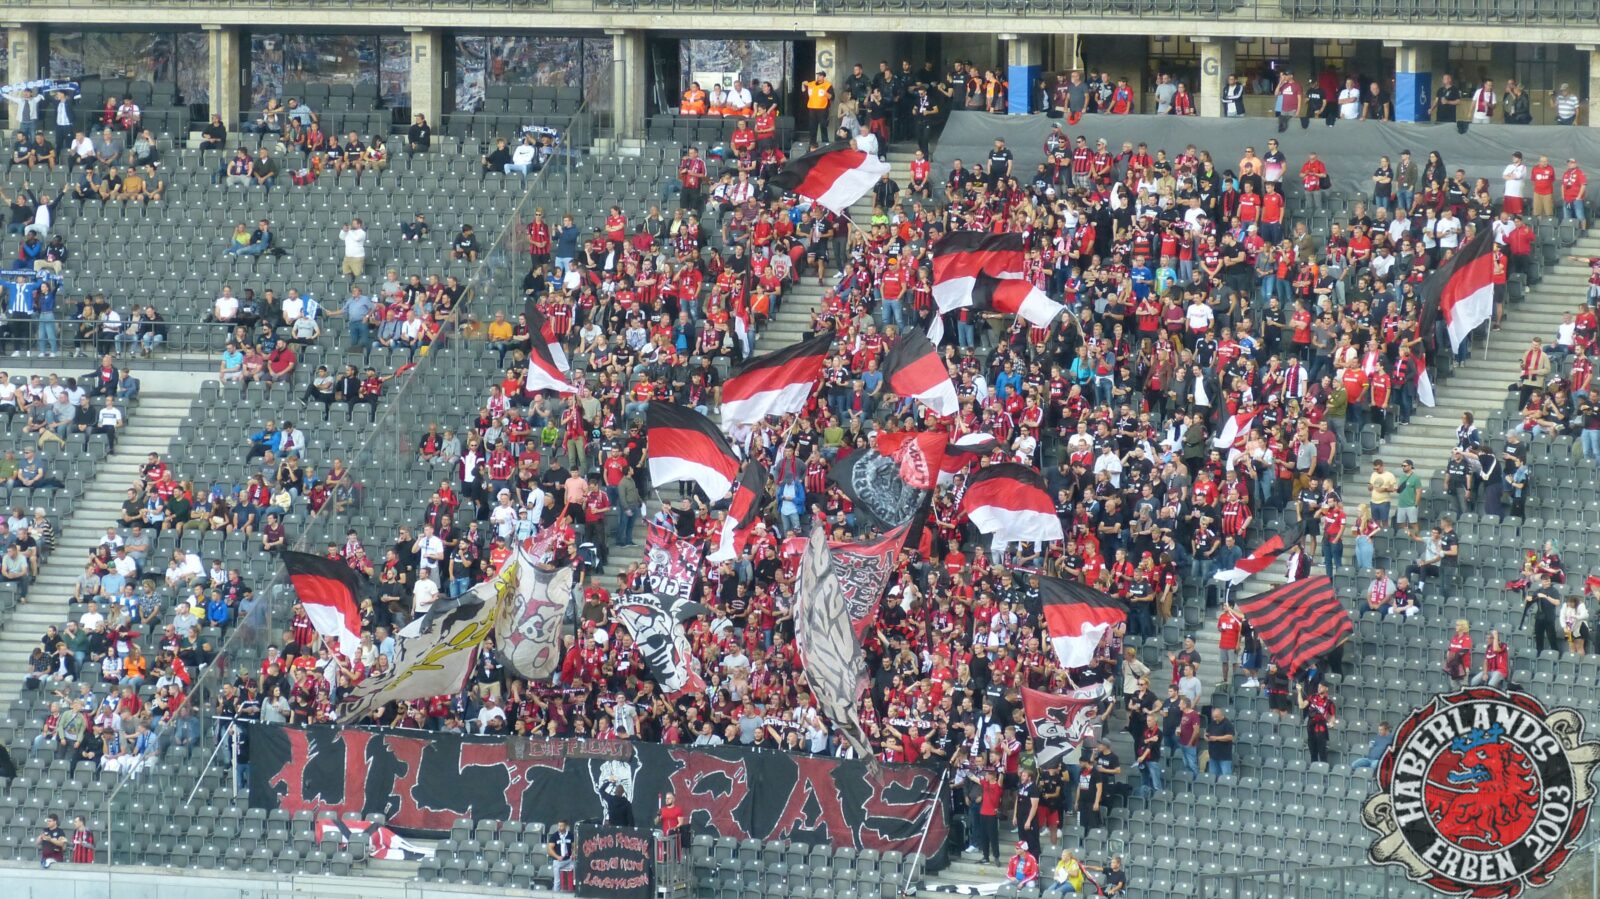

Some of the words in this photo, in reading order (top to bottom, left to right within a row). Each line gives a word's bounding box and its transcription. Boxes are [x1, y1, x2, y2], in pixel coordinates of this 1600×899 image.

[12, 41, 25, 59] F
[415, 45, 427, 63] F
[817, 49, 834, 69] G
[1203, 57, 1219, 76] G
[268, 727, 950, 858] ULTRAS
